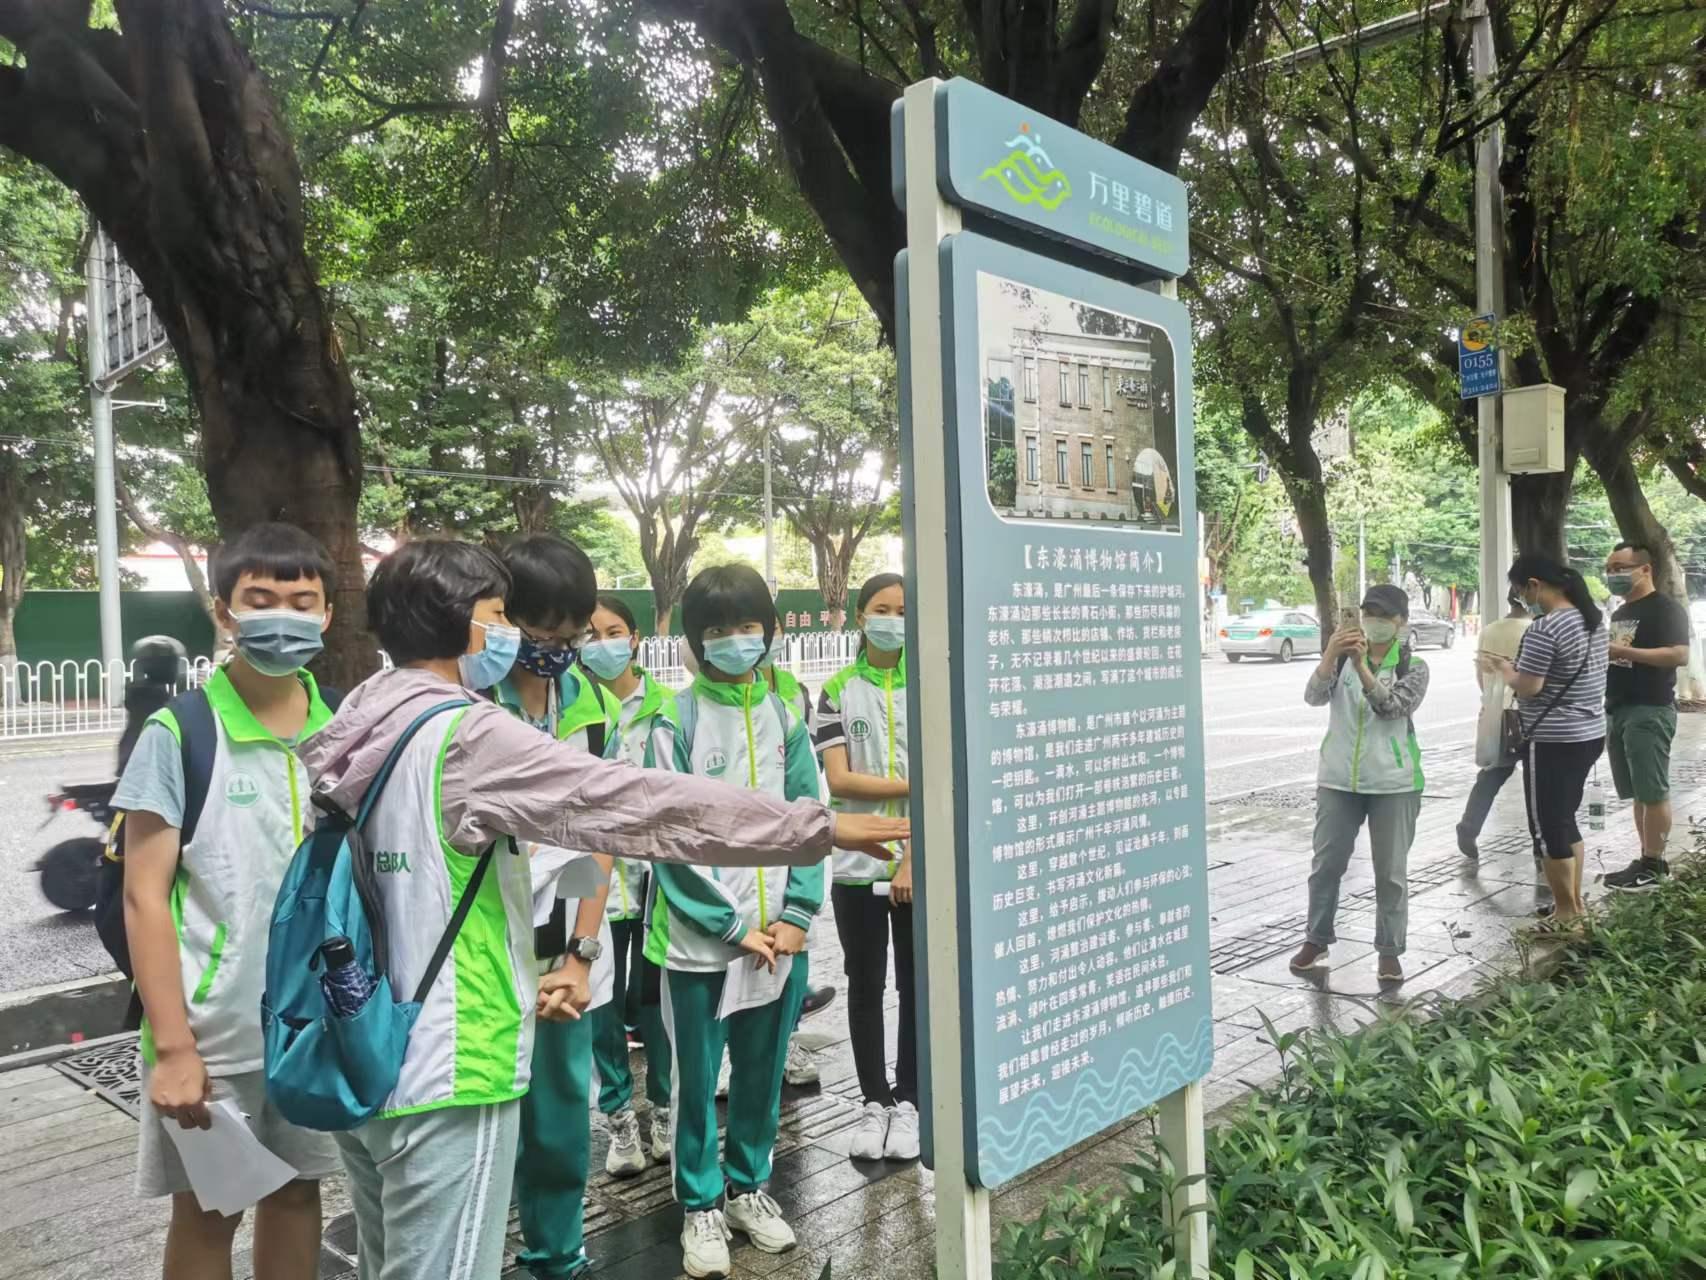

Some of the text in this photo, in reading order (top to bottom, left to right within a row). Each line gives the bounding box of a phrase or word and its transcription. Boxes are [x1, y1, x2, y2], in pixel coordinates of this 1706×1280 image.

[1088, 171, 1173, 232] 万里碧道
[1464, 354, 1493, 368] 0155
[1024, 544, 1162, 573] 【东濠涌博物馆简介】
[785, 611, 811, 627] 自由
[990, 698, 1026, 718] 与荣耀。
